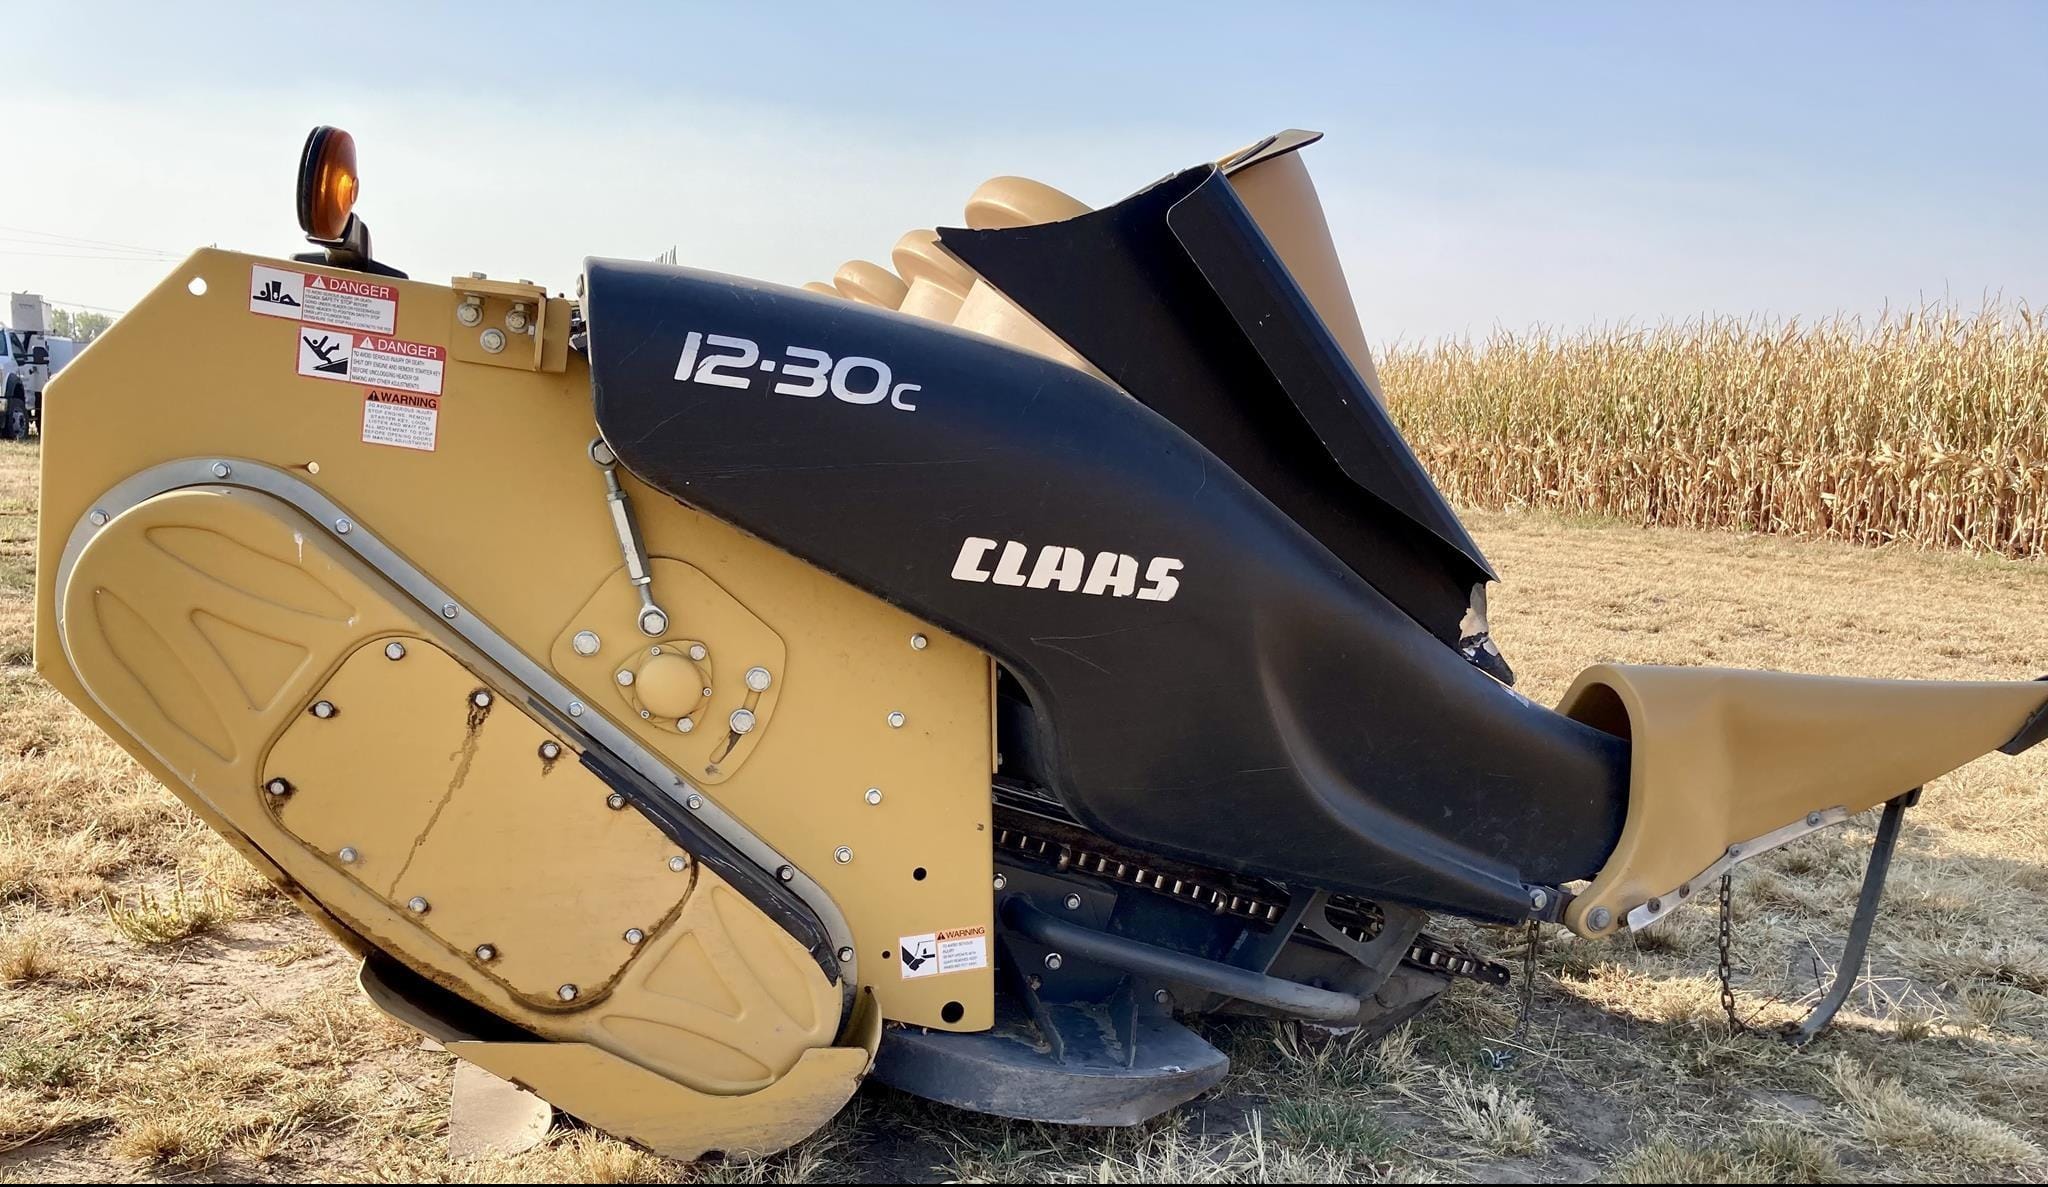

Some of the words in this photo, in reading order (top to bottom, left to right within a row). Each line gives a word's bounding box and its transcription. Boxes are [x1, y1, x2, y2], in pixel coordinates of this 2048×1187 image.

[330, 279, 389, 298] DANGER
[377, 339, 437, 358] DANGER
[353, 366, 368, 374] BEFORE
[381, 392, 437, 408] WARNING
[951, 536, 1184, 602] CLAAS
[946, 927, 985, 938] WARNING
